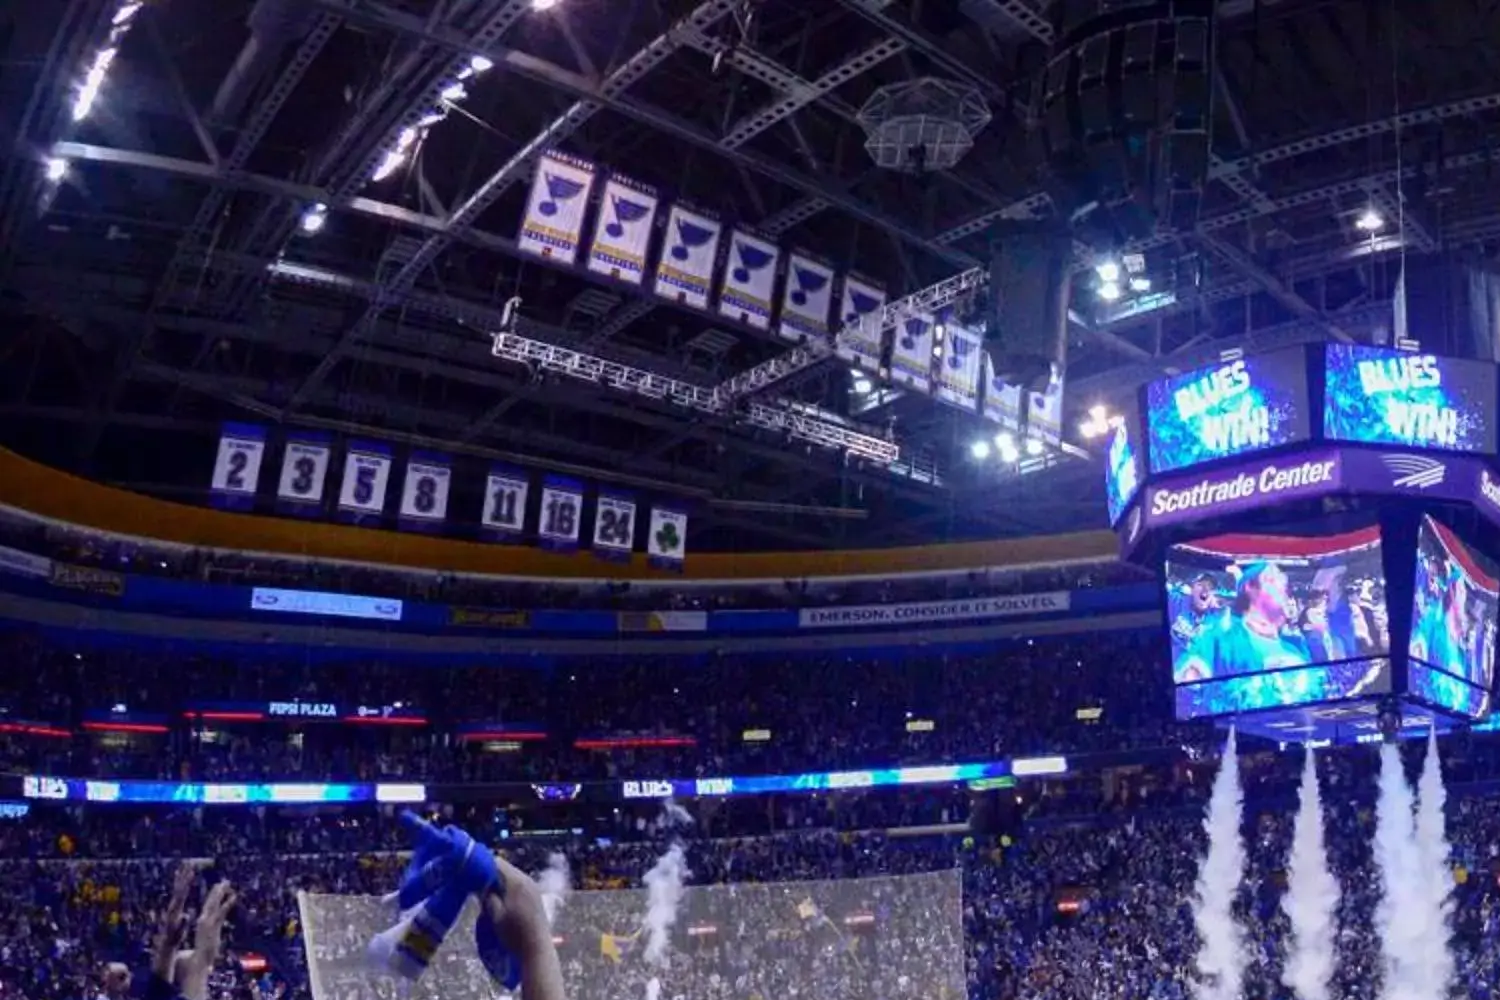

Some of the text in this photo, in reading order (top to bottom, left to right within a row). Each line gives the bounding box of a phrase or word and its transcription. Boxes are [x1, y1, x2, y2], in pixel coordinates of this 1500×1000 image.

[1174, 360, 1250, 422] BLUES
[1358, 355, 1440, 396] BLUES
[227, 451, 248, 488] 2
[292, 456, 316, 494] 3
[354, 465, 377, 504] 5
[1152, 461, 1335, 515] Scottrade Center
[415, 474, 436, 512] 8
[491, 486, 517, 524] 11
[600, 508, 630, 544] 24
[300, 703, 338, 717] PLAZA
